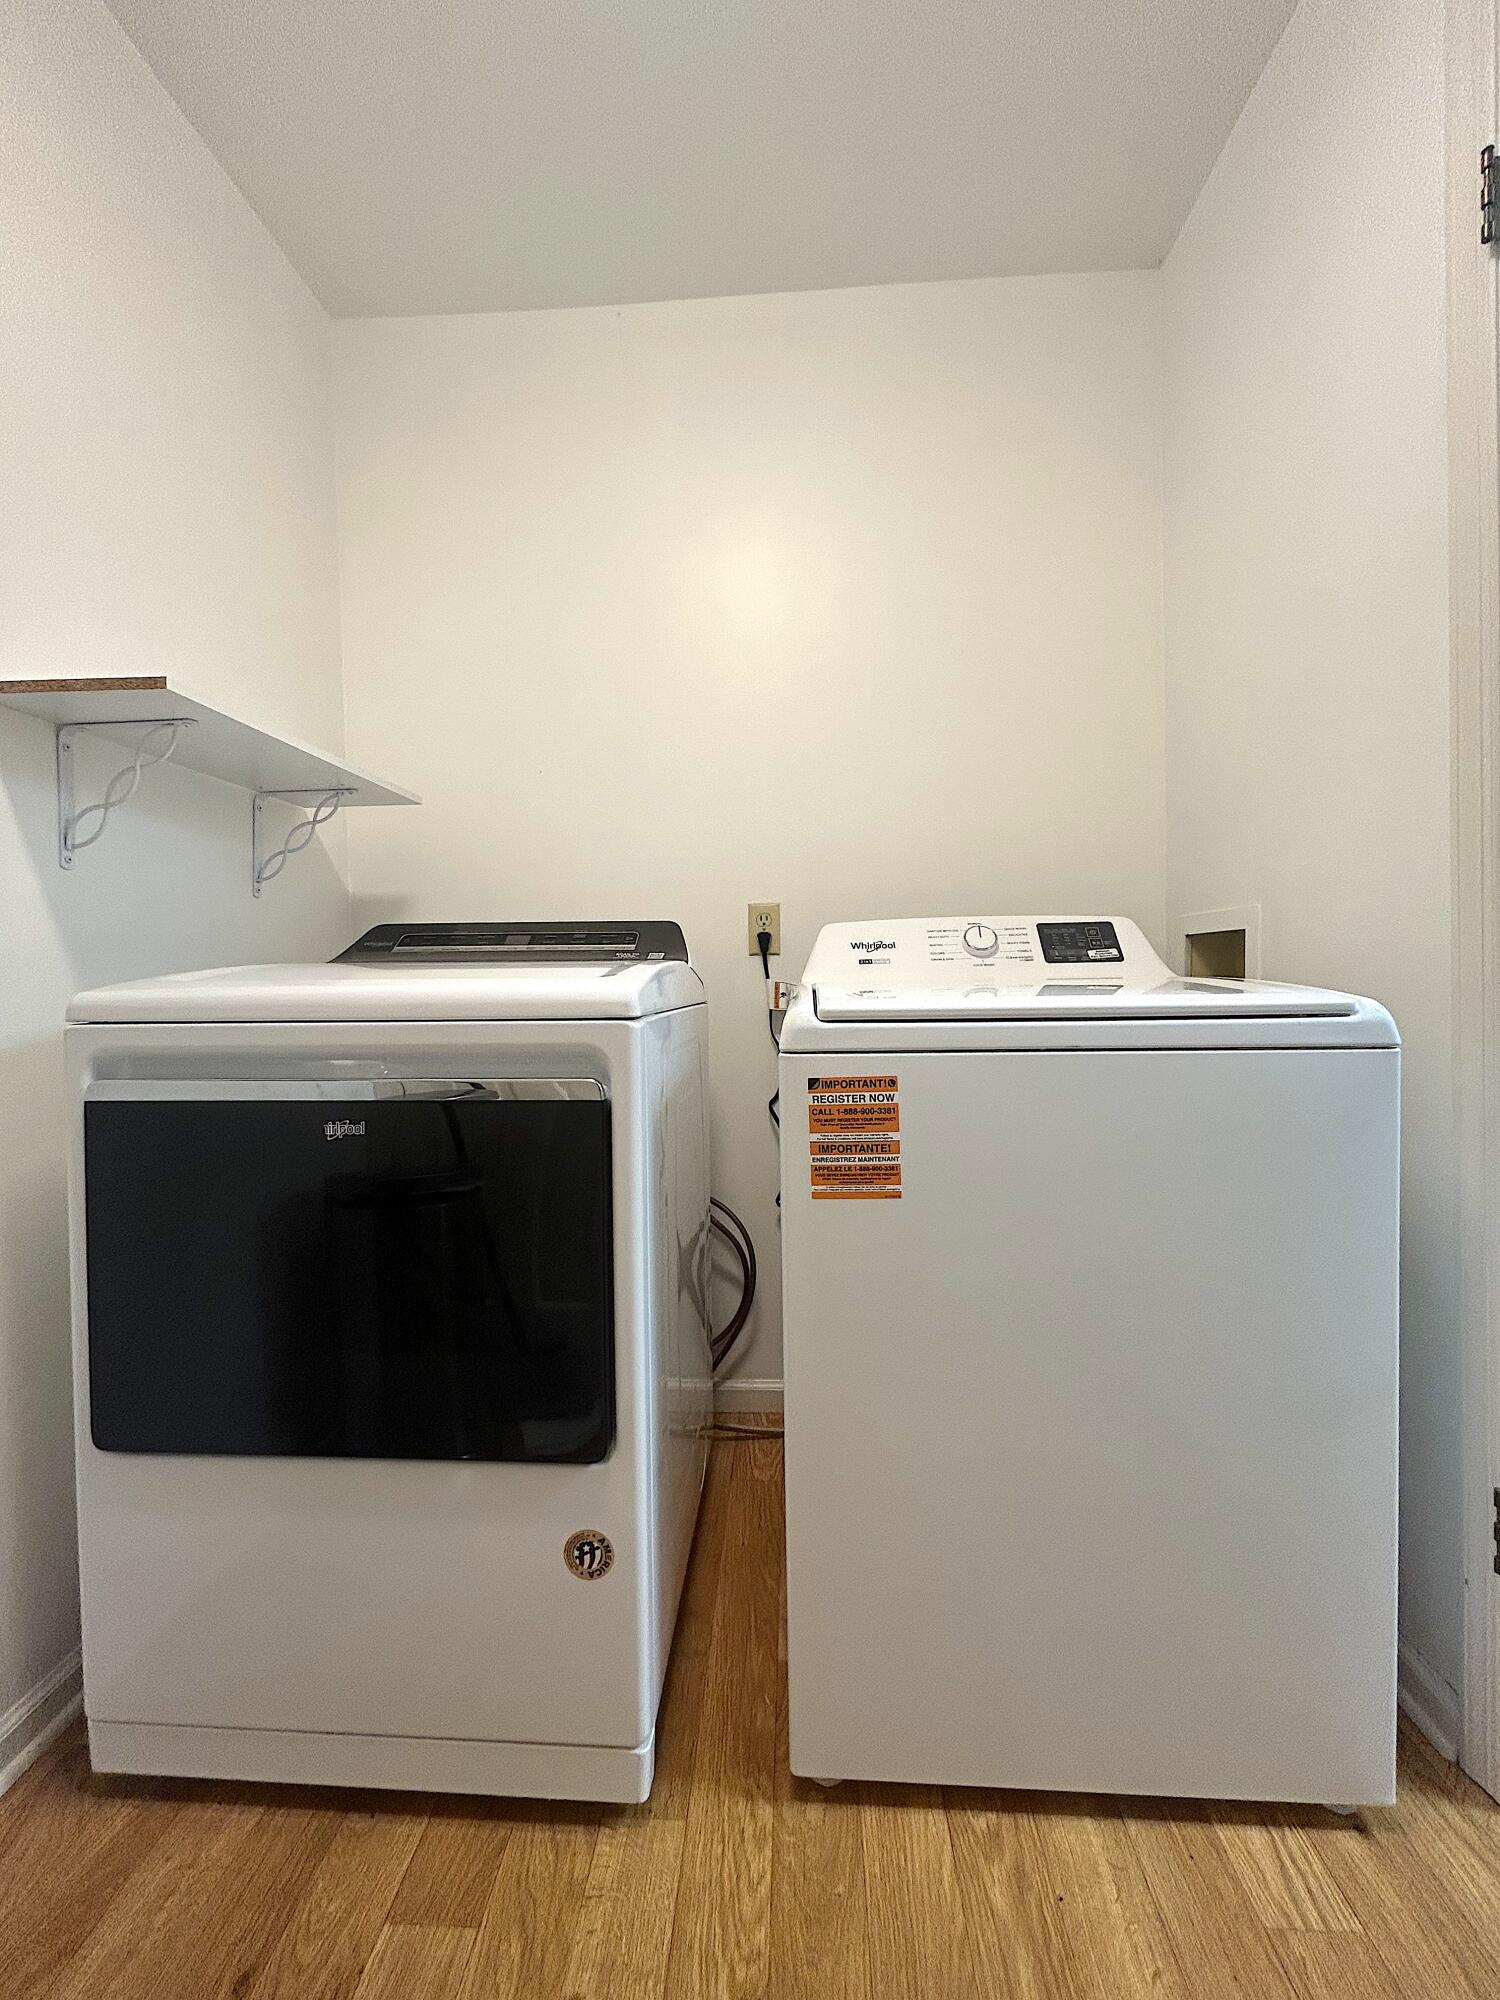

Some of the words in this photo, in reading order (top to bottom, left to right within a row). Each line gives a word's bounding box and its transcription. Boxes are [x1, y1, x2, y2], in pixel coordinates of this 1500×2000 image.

[850, 941, 896, 952] Whirlpool
[821, 1079, 886, 1089] IMPORTANT!
[812, 1094, 866, 1103] REGISTER
[869, 1093, 895, 1102] NOW
[812, 1108, 834, 1116] CALL
[836, 1107, 896, 1115] 1-888-900-3381
[323, 1120, 366, 1140] irlpool
[818, 1144, 891, 1153] IMPORTANTE!
[588, 1538, 612, 1578] AMERICA
